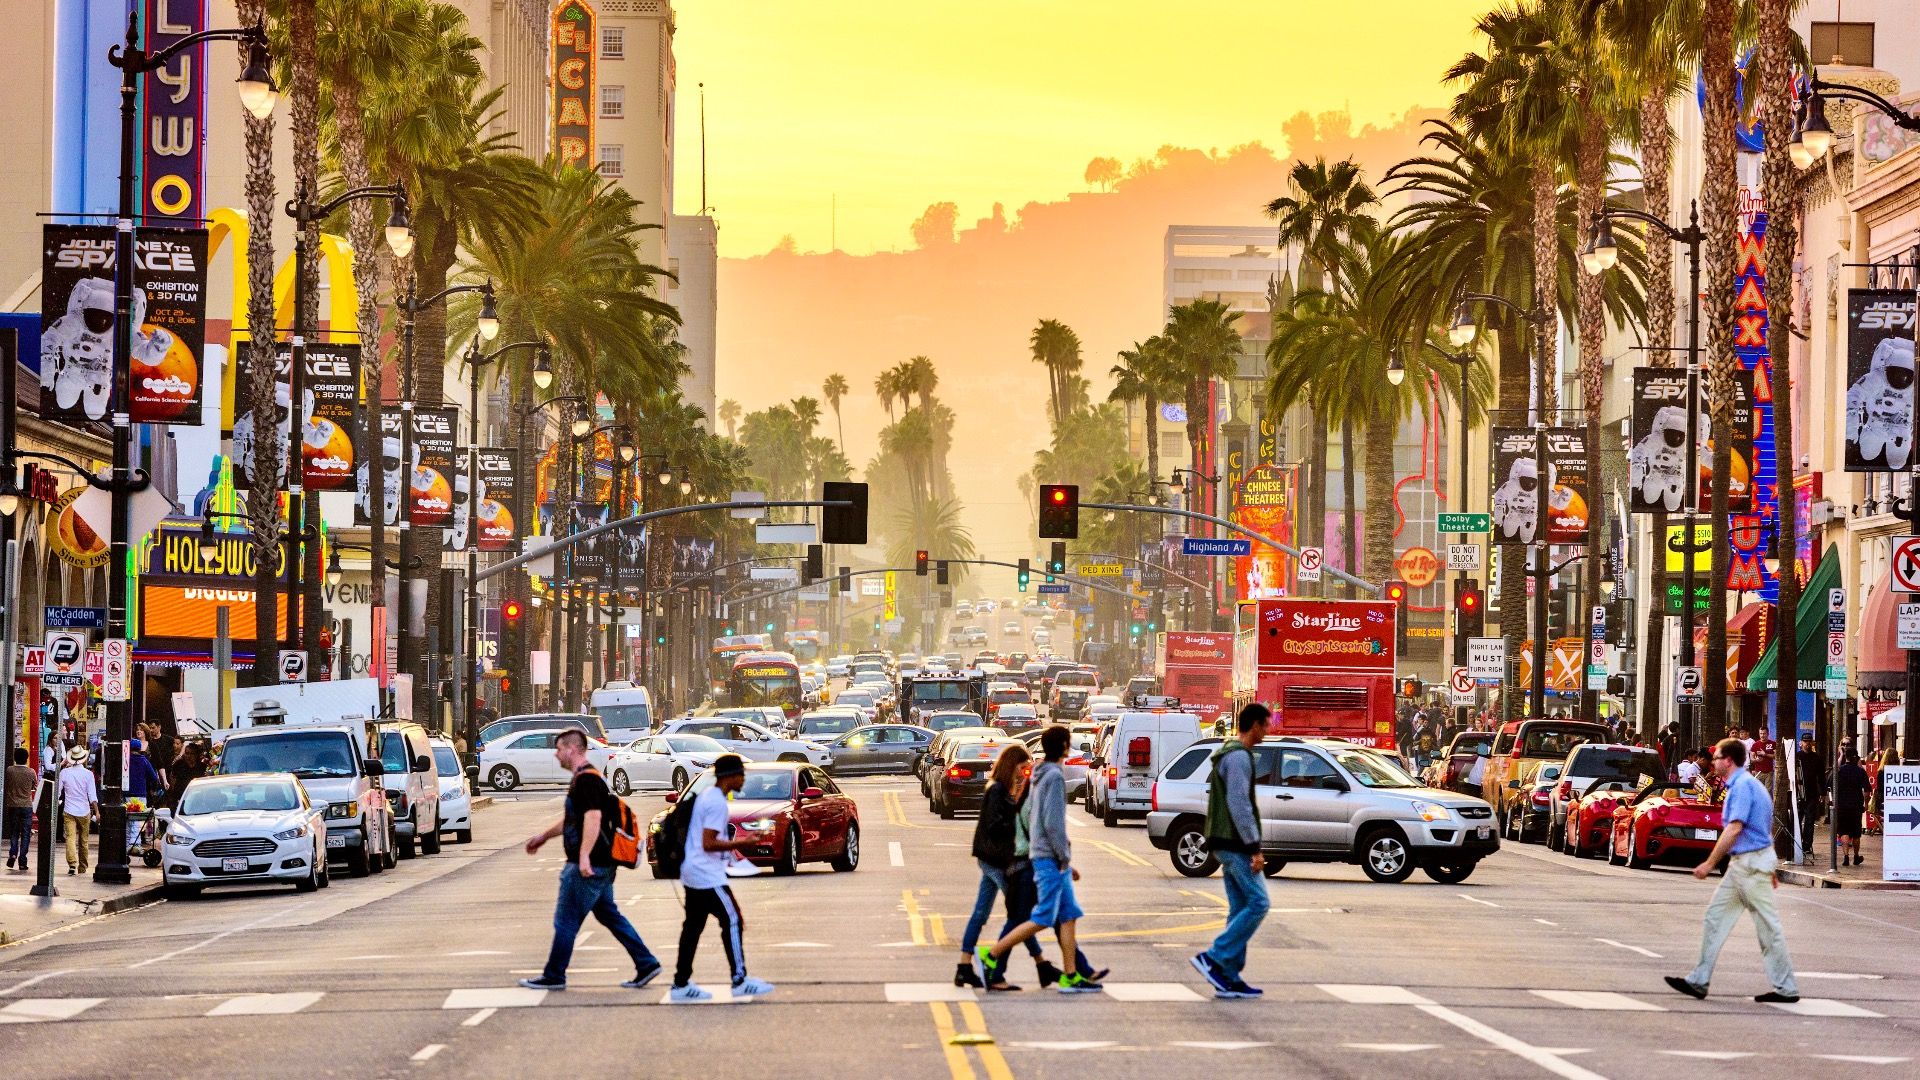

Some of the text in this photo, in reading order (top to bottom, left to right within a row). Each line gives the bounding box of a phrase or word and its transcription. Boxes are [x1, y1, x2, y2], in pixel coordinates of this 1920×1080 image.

[557, 21, 590, 53] EL
[60, 239, 174, 251] JOURNEY
[54, 249, 196, 272] SPACE
[146, 281, 199, 292] EXHIBITION
[1736, 231, 1768, 347] WAX
[147, 292, 197, 302] & 3D FILM
[1863, 302, 1916, 311] JOUR
[314, 384, 354, 392] EXHIBITION
[335, 392, 353, 400] FILM
[1500, 441, 1585, 453] SPACE
[1257, 469, 1272, 480] TCL
[1246, 482, 1281, 494] CHINESE
[1243, 494, 1285, 505] THEATRES
[1445, 515, 1470, 524] Dolby
[1441, 523, 1475, 531] Theatre
[1189, 542, 1245, 555] Highland Av
[1451, 546, 1475, 554] DO NOT
[59, 548, 86, 567] Since
[1453, 554, 1474, 562] BLOCK
[1082, 566, 1099, 574] PED
[1101, 566, 1120, 574] XING
[1409, 573, 1427, 581] CAFE
[47, 608, 95, 620] McCadden
[1900, 606, 1920, 615] LAP
[47, 619, 62, 627] 1700
[65, 619, 70, 627] N
[585, 625, 593, 657] ZARA
[26, 650, 46, 666] AT
[86, 652, 104, 666] AT
[1474, 654, 1502, 662] MUST
[45, 675, 81, 685] PAY HERE
[1797, 680, 1828, 691] GALORE
[1885, 773, 1920, 784] PUBLI
[1885, 786, 1920, 797] PARKIN
